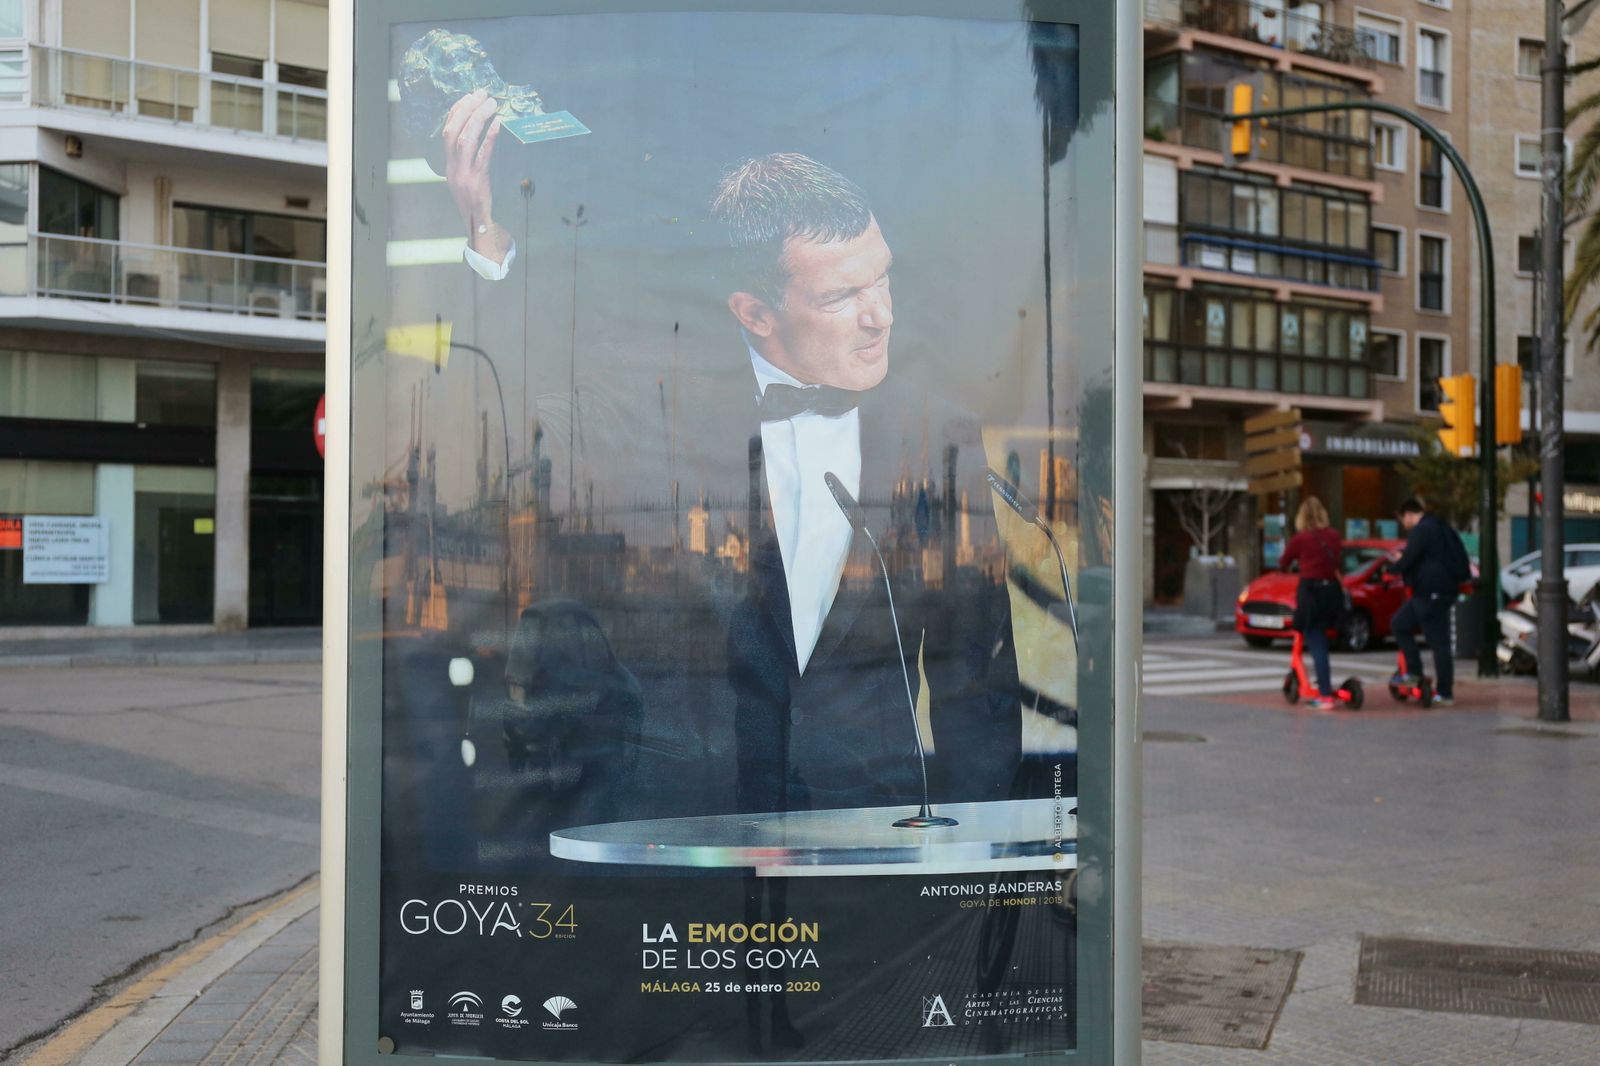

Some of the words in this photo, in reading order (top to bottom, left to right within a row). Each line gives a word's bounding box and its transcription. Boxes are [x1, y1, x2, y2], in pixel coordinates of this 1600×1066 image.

[1054, 763, 1062, 803] ORTEGA
[1054, 804, 1062, 848] ALBERTO
[459, 884, 518, 896] PREMIOS
[920, 884, 984, 897] ANTONIO
[989, 881, 1062, 894] BANDERAS
[960, 900, 986, 909] GOYA
[989, 899, 1000, 907] DE
[1003, 898, 1036, 906] HONOR
[1043, 896, 1063, 905] 2015
[400, 899, 522, 938] GOYA
[528, 903, 578, 939] 34
[642, 923, 678, 943] LA
[688, 917, 819, 943] EMOCIÓN
[642, 949, 678, 969] DE
[687, 949, 737, 969] LOS
[746, 949, 820, 969] GOYA
[641, 980, 700, 993] MÁLAGA
[704, 982, 721, 993] 25
[725, 982, 741, 993] de
[745, 984, 782, 993] enero
[786, 981, 821, 992] 2020
[965, 991, 1020, 999] ACADEMIA
[965, 1000, 990, 1008] ARTES
[1027, 996, 1063, 1004] CIENCIAS
[965, 1005, 1063, 1018] CINEMATOGRÁFICAS
